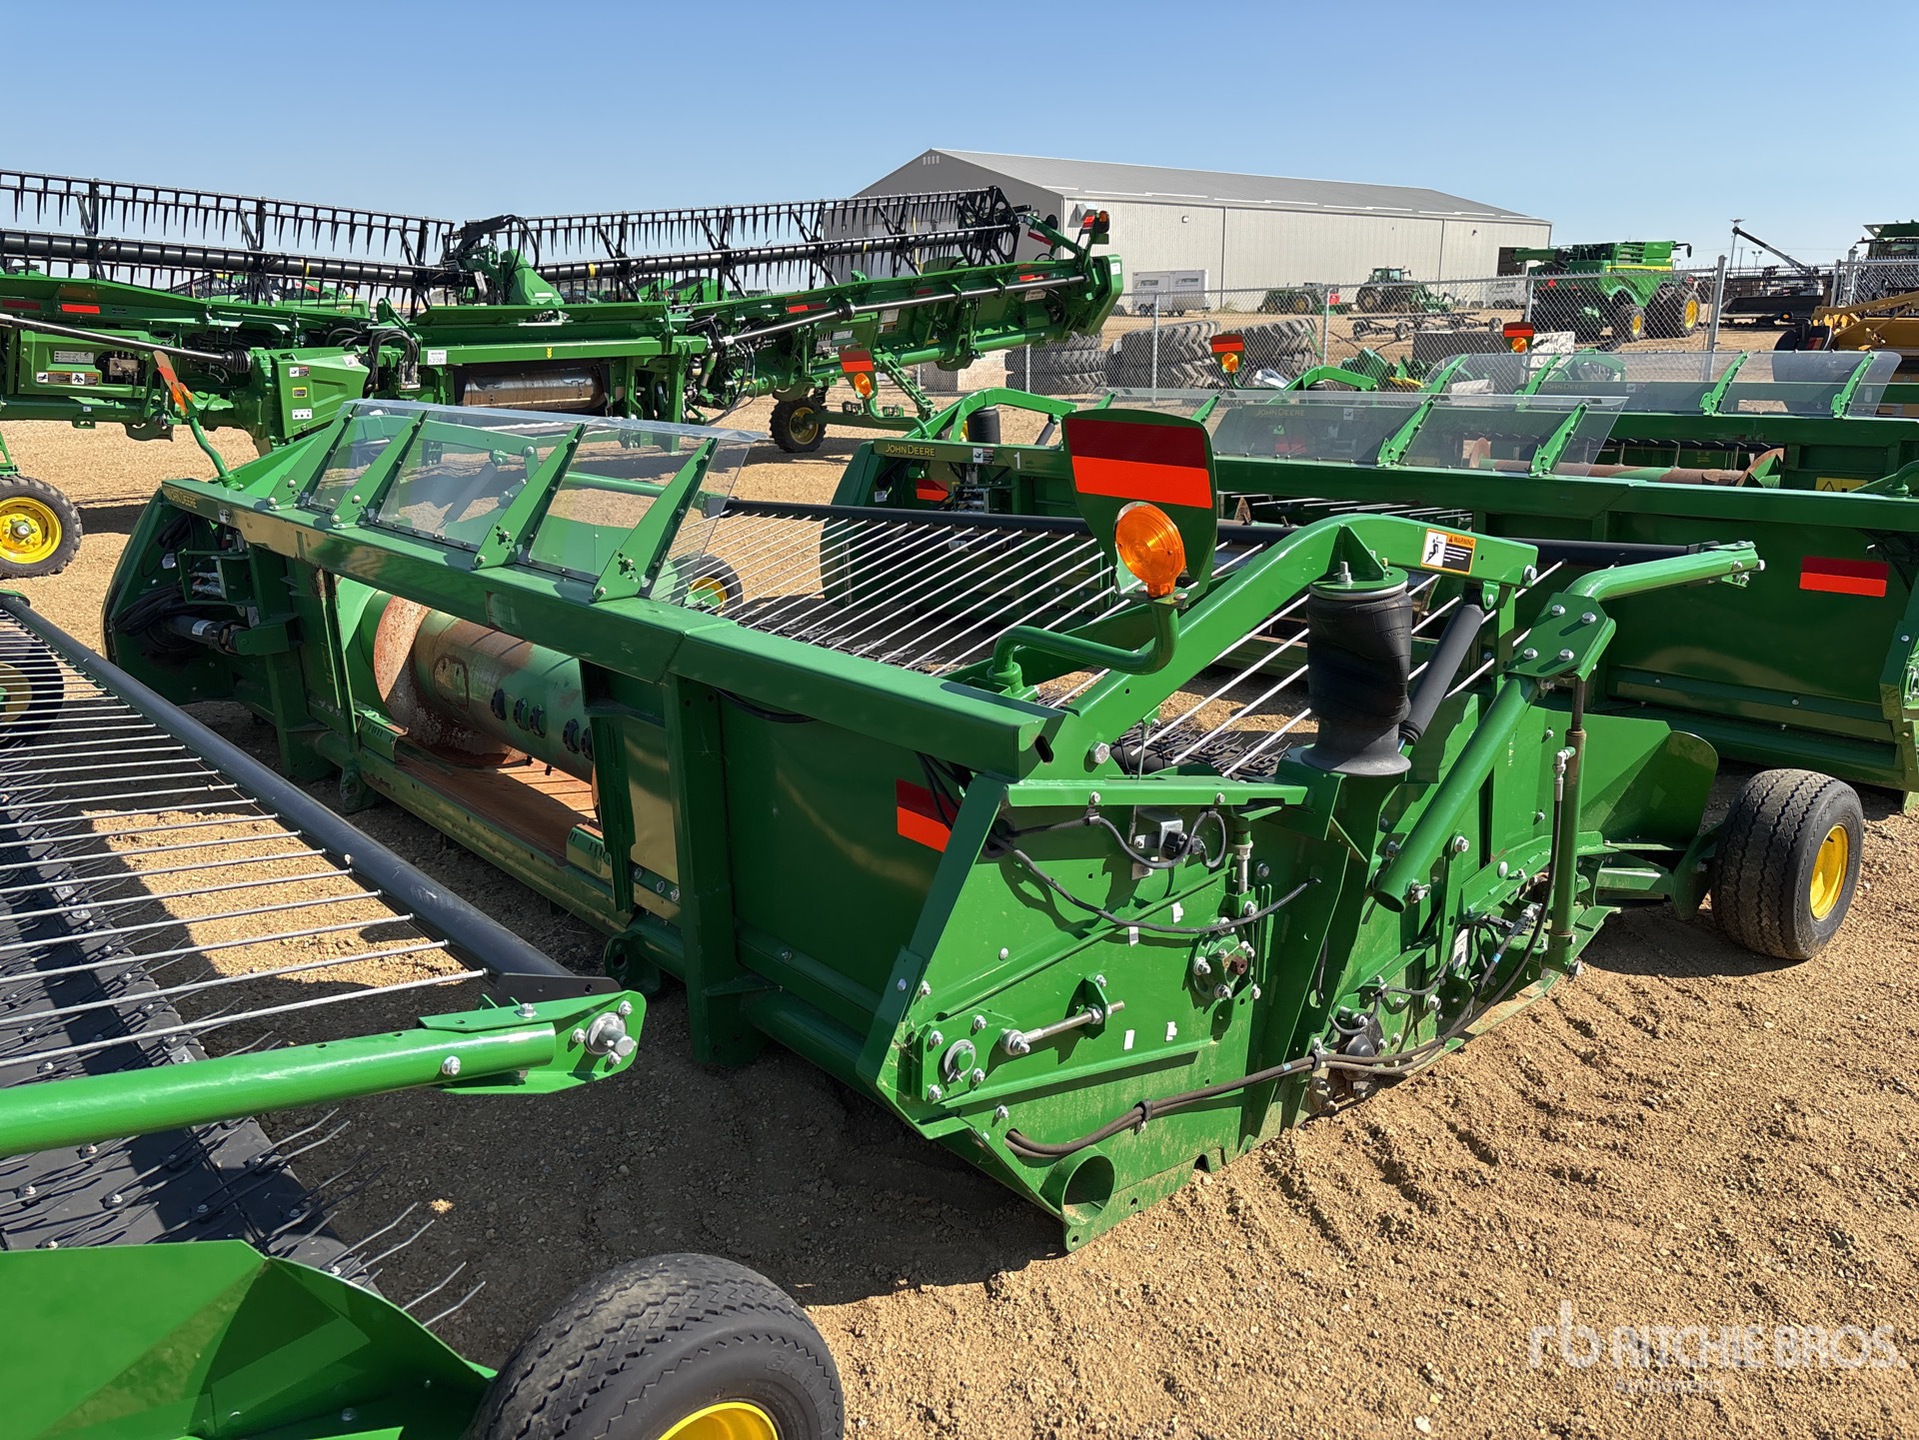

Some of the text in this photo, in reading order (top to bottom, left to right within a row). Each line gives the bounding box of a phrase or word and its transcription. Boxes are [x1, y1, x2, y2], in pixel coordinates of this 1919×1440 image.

[1256, 407, 1306, 417] JOHN DEERE
[885, 443, 936, 457] JOHN DEERE
[1453, 536, 1474, 547] WARNING
